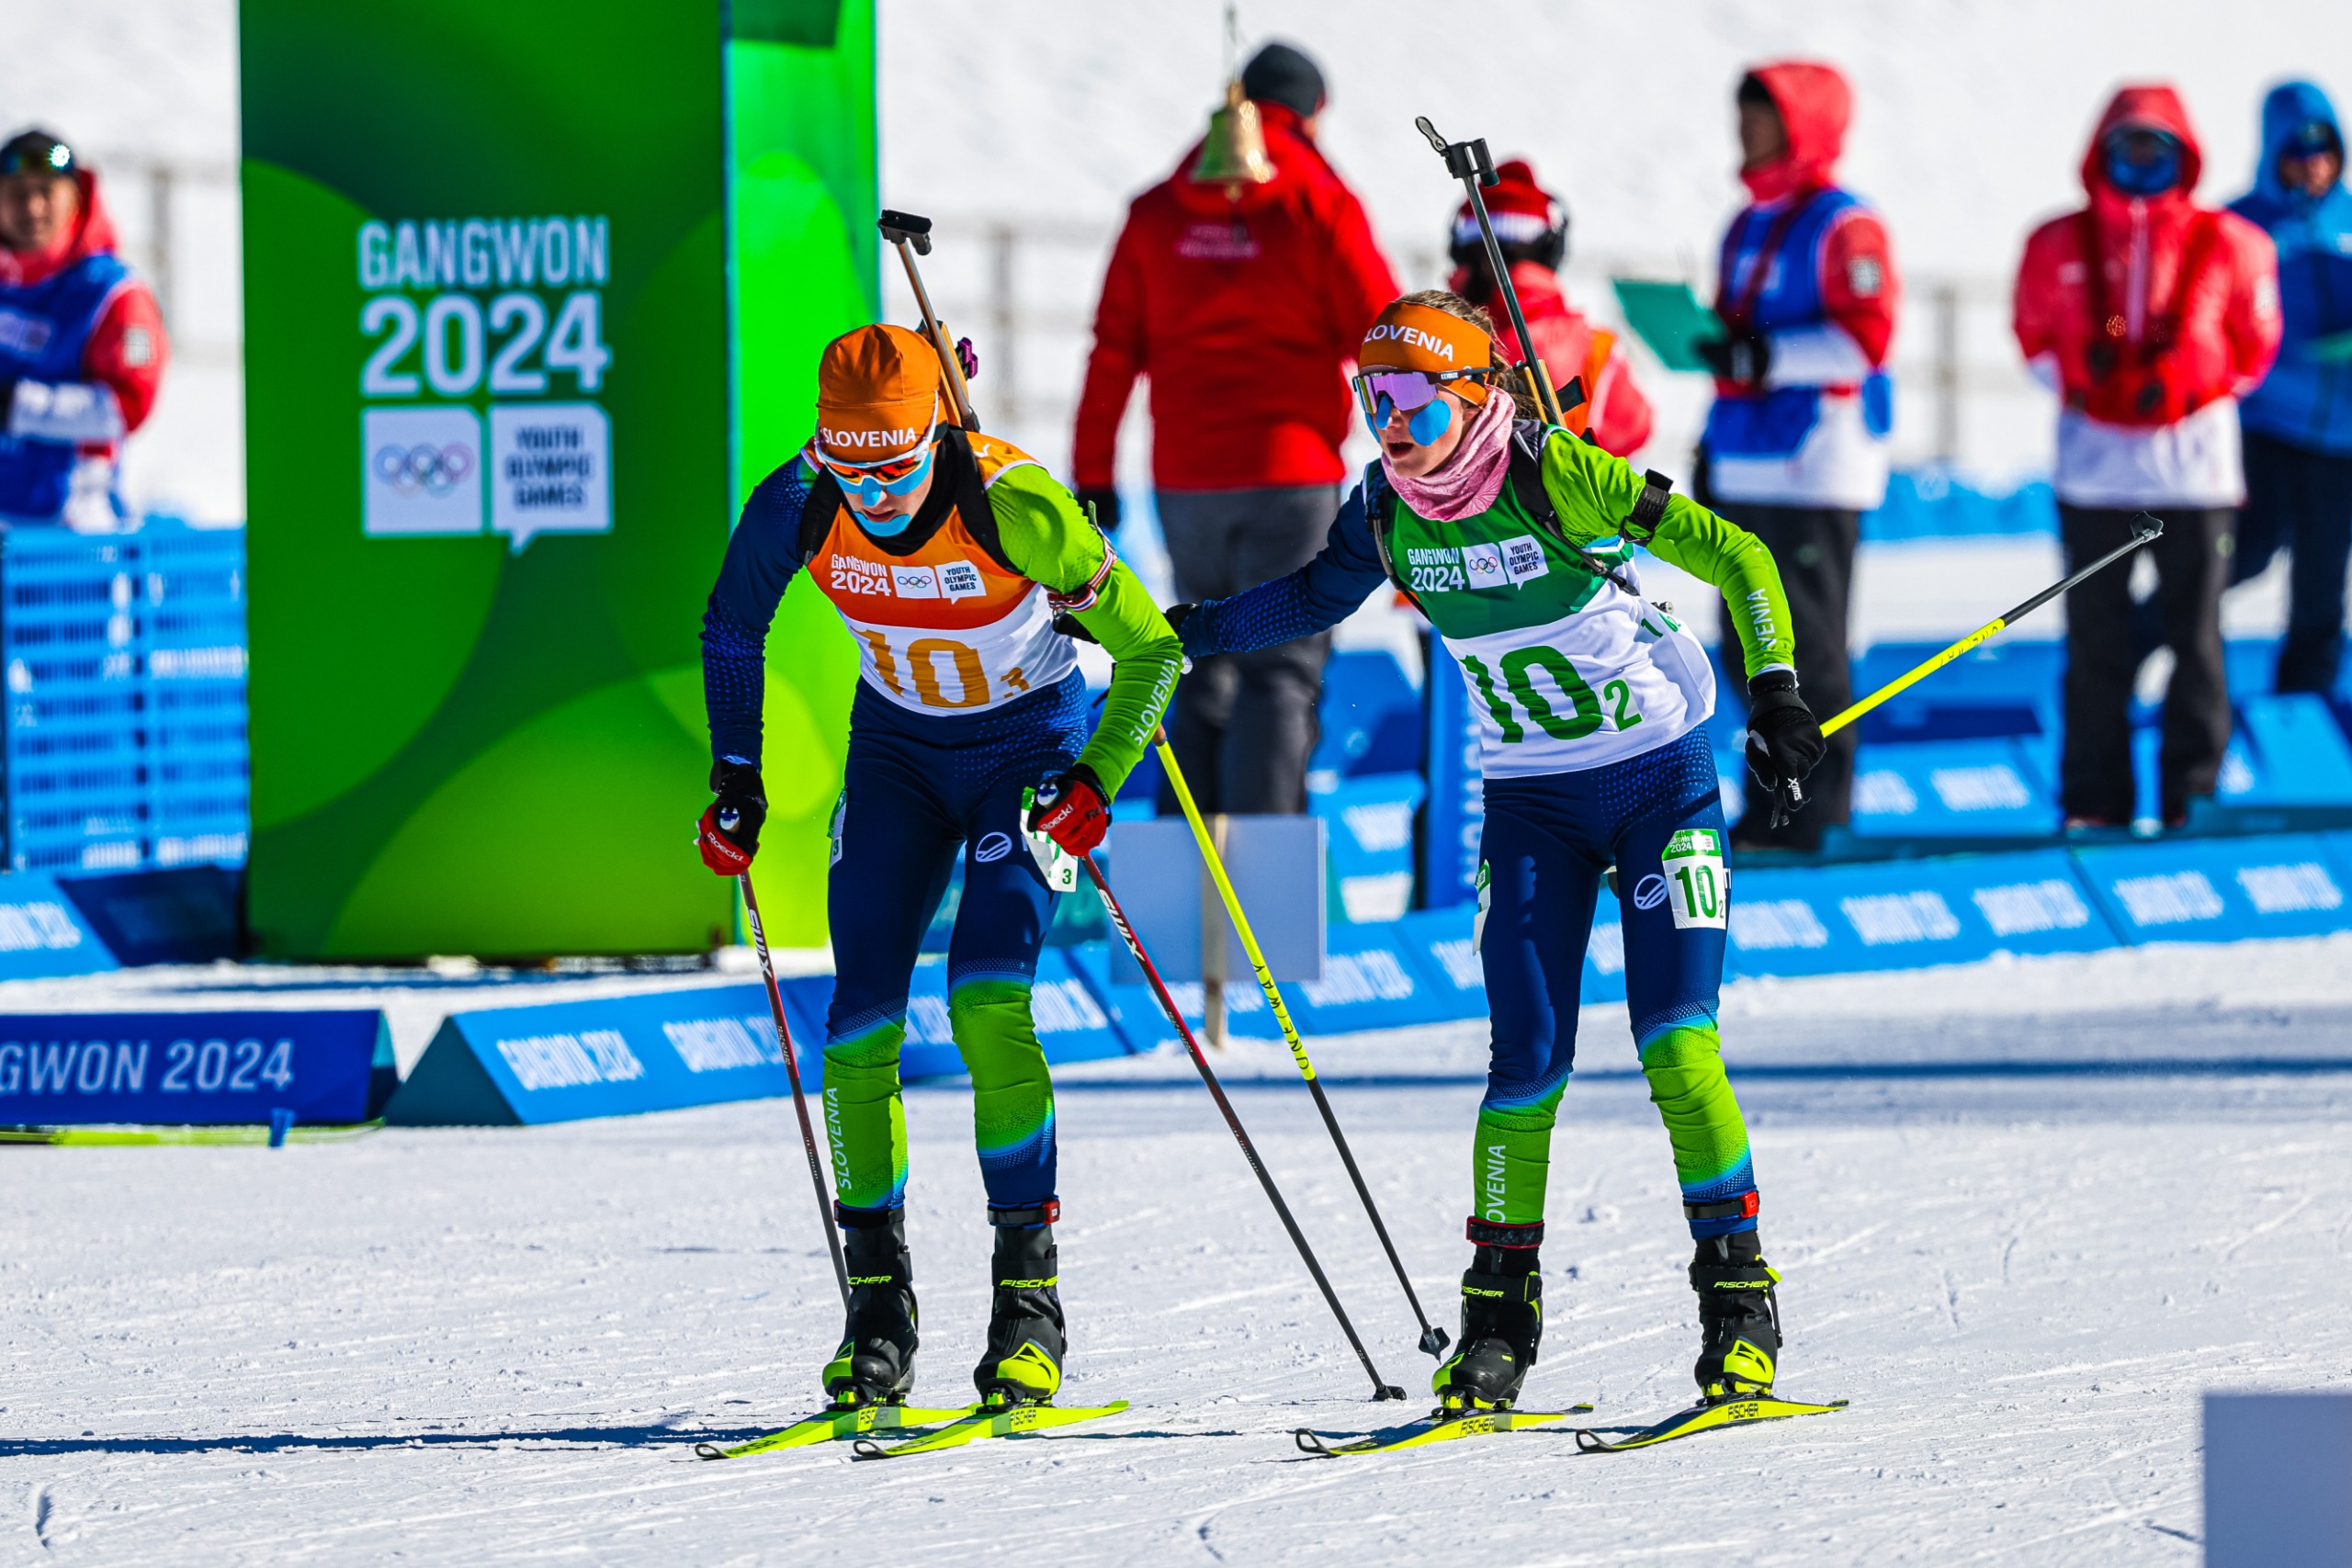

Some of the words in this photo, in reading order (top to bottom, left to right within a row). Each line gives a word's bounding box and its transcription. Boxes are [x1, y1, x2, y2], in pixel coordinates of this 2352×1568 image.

[359, 218, 608, 288] GANGWON
[361, 291, 612, 396] 2024
[1364, 324, 1453, 362] LOVENIA
[822, 427, 917, 447] SLOVENIA
[1408, 547, 1460, 565] GANGWON
[1510, 543, 1532, 555] YOUTH
[1510, 551, 1539, 566] OLYMPIC
[831, 554, 888, 577] GANGWON
[946, 566, 971, 576] YOUTH
[1514, 561, 1538, 575] GAMES
[831, 570, 891, 596] 2024
[944, 574, 977, 584] OLYMPIC
[949, 582, 976, 592] GAMES
[1411, 566, 1465, 592] 2024
[1747, 588, 1777, 650] VENIA
[850, 626, 989, 706] 10
[1130, 659, 1178, 746] SLOVENIA
[1458, 646, 1603, 743] 10
[1603, 679, 1643, 731] 2
[1041, 804, 1073, 830] Roeckl
[707, 831, 743, 862] Roeckl
[1670, 842, 1691, 853] 2024
[1062, 868, 1072, 885] 3
[1675, 864, 1717, 919] 10
[1719, 900, 1724, 919] 2
[0, 1039, 149, 1094] GWON
[161, 1038, 294, 1092] 2024
[827, 1087, 852, 1190] SLOVENIA
[1486, 1145, 1506, 1223] OVENIA
[847, 1275, 892, 1285] CHER
[1713, 1280, 1770, 1289] FISCHER
[1728, 1403, 1759, 1420] FISCHER
[1460, 1417, 1495, 1436] FISCHER
